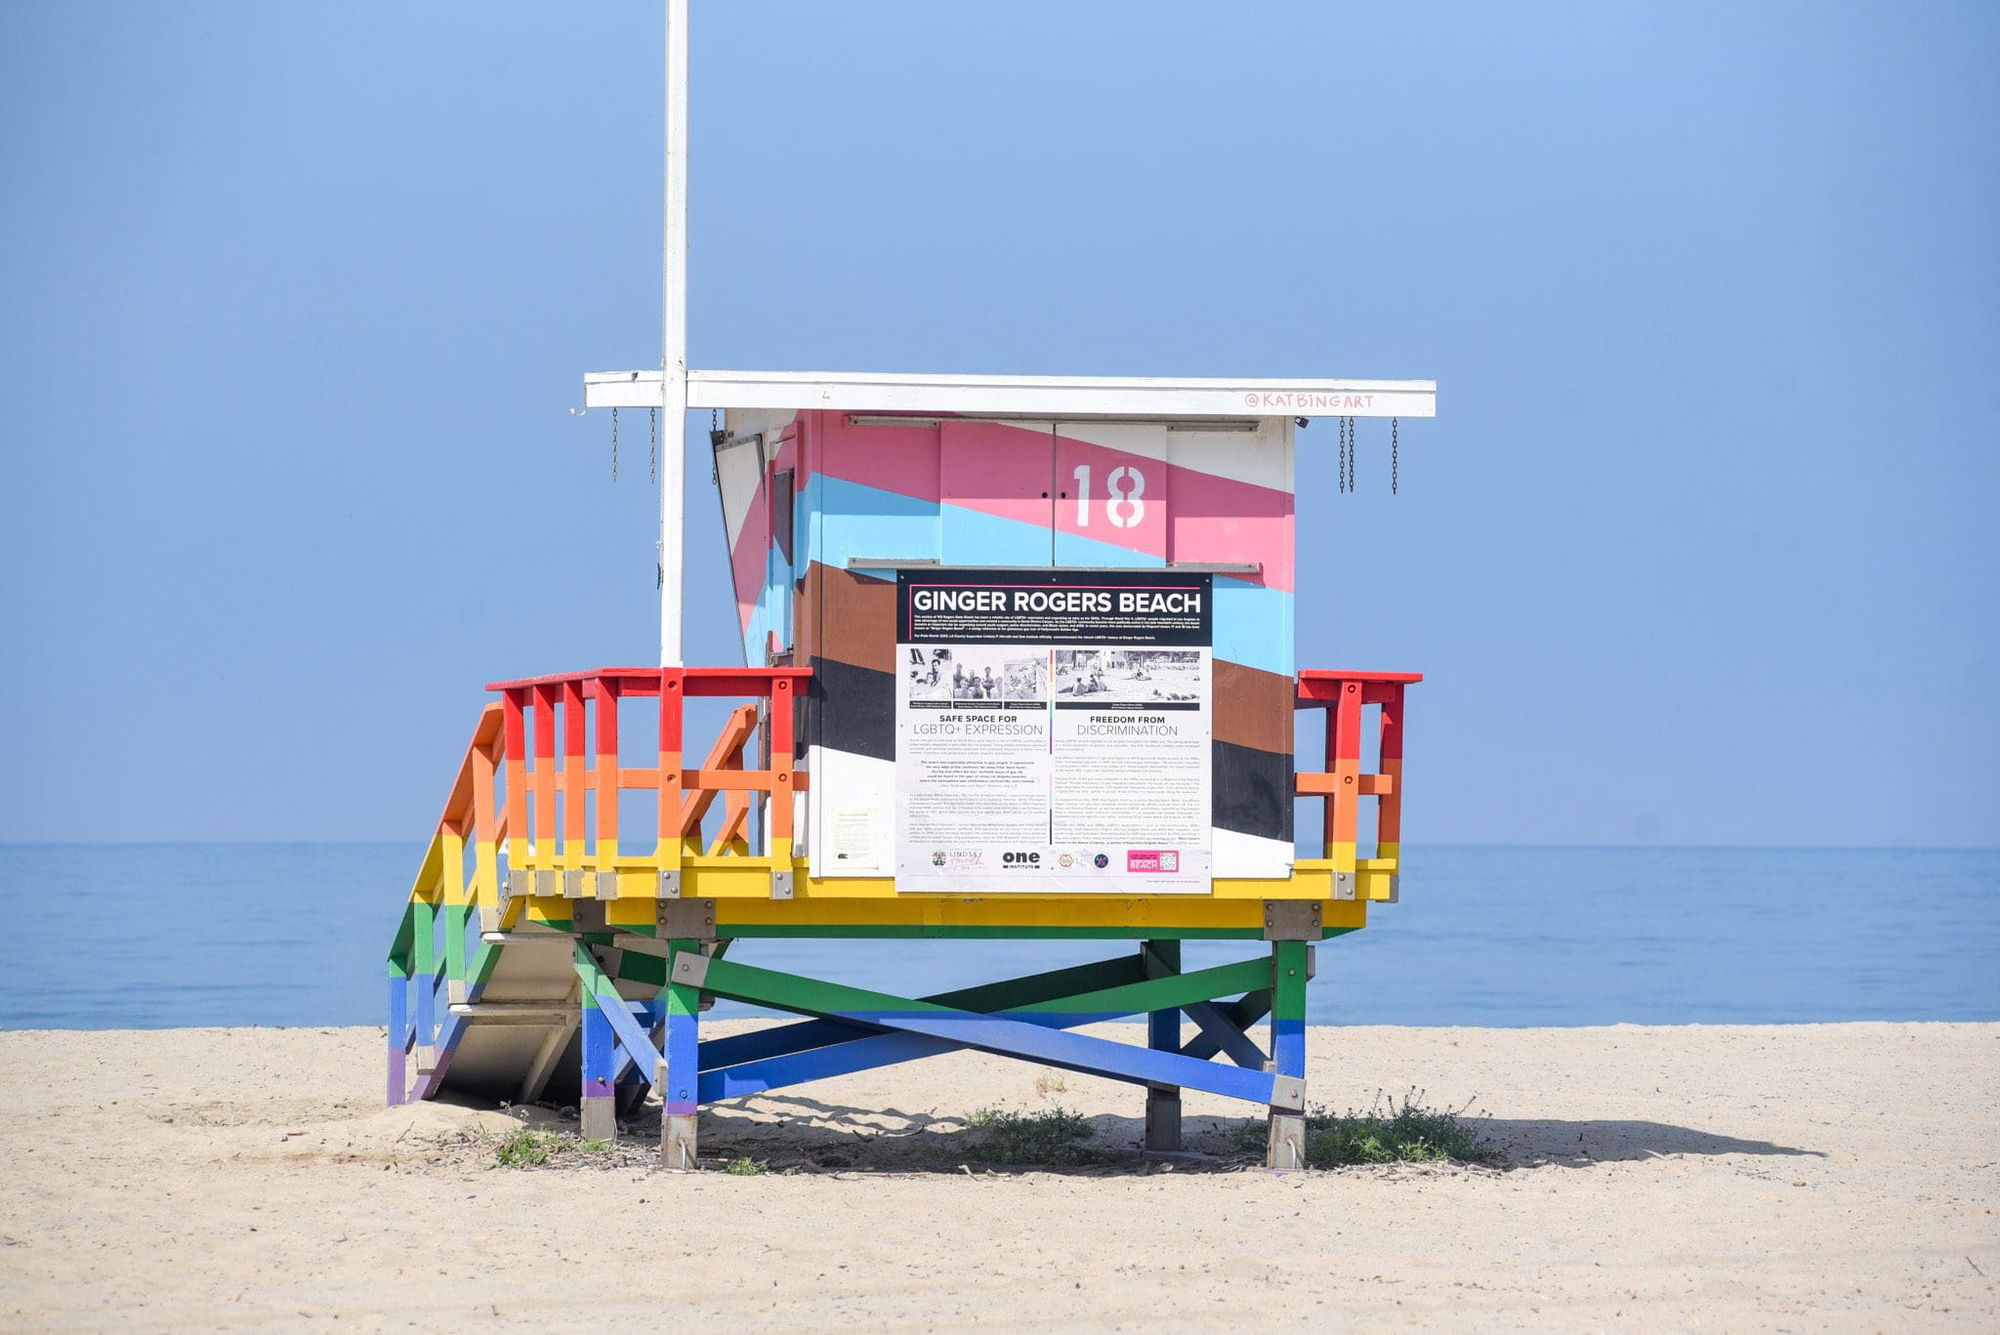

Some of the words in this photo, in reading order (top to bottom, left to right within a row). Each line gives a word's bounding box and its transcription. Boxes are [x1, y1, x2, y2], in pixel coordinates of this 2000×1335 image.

[1245, 393, 1373, 408] @KATBINGART
[1073, 465, 1145, 528] 18
[914, 591, 1006, 611] GINGER
[1014, 592, 1112, 612] ROGERS
[1120, 593, 1200, 613] BEACH
[998, 715, 1018, 723] FOR
[914, 724, 960, 735] LGBTQ+
[965, 724, 1043, 735] EXPRESSION
[1077, 725, 1178, 736] DISCRIMINATION
[1003, 852, 1040, 863] one
